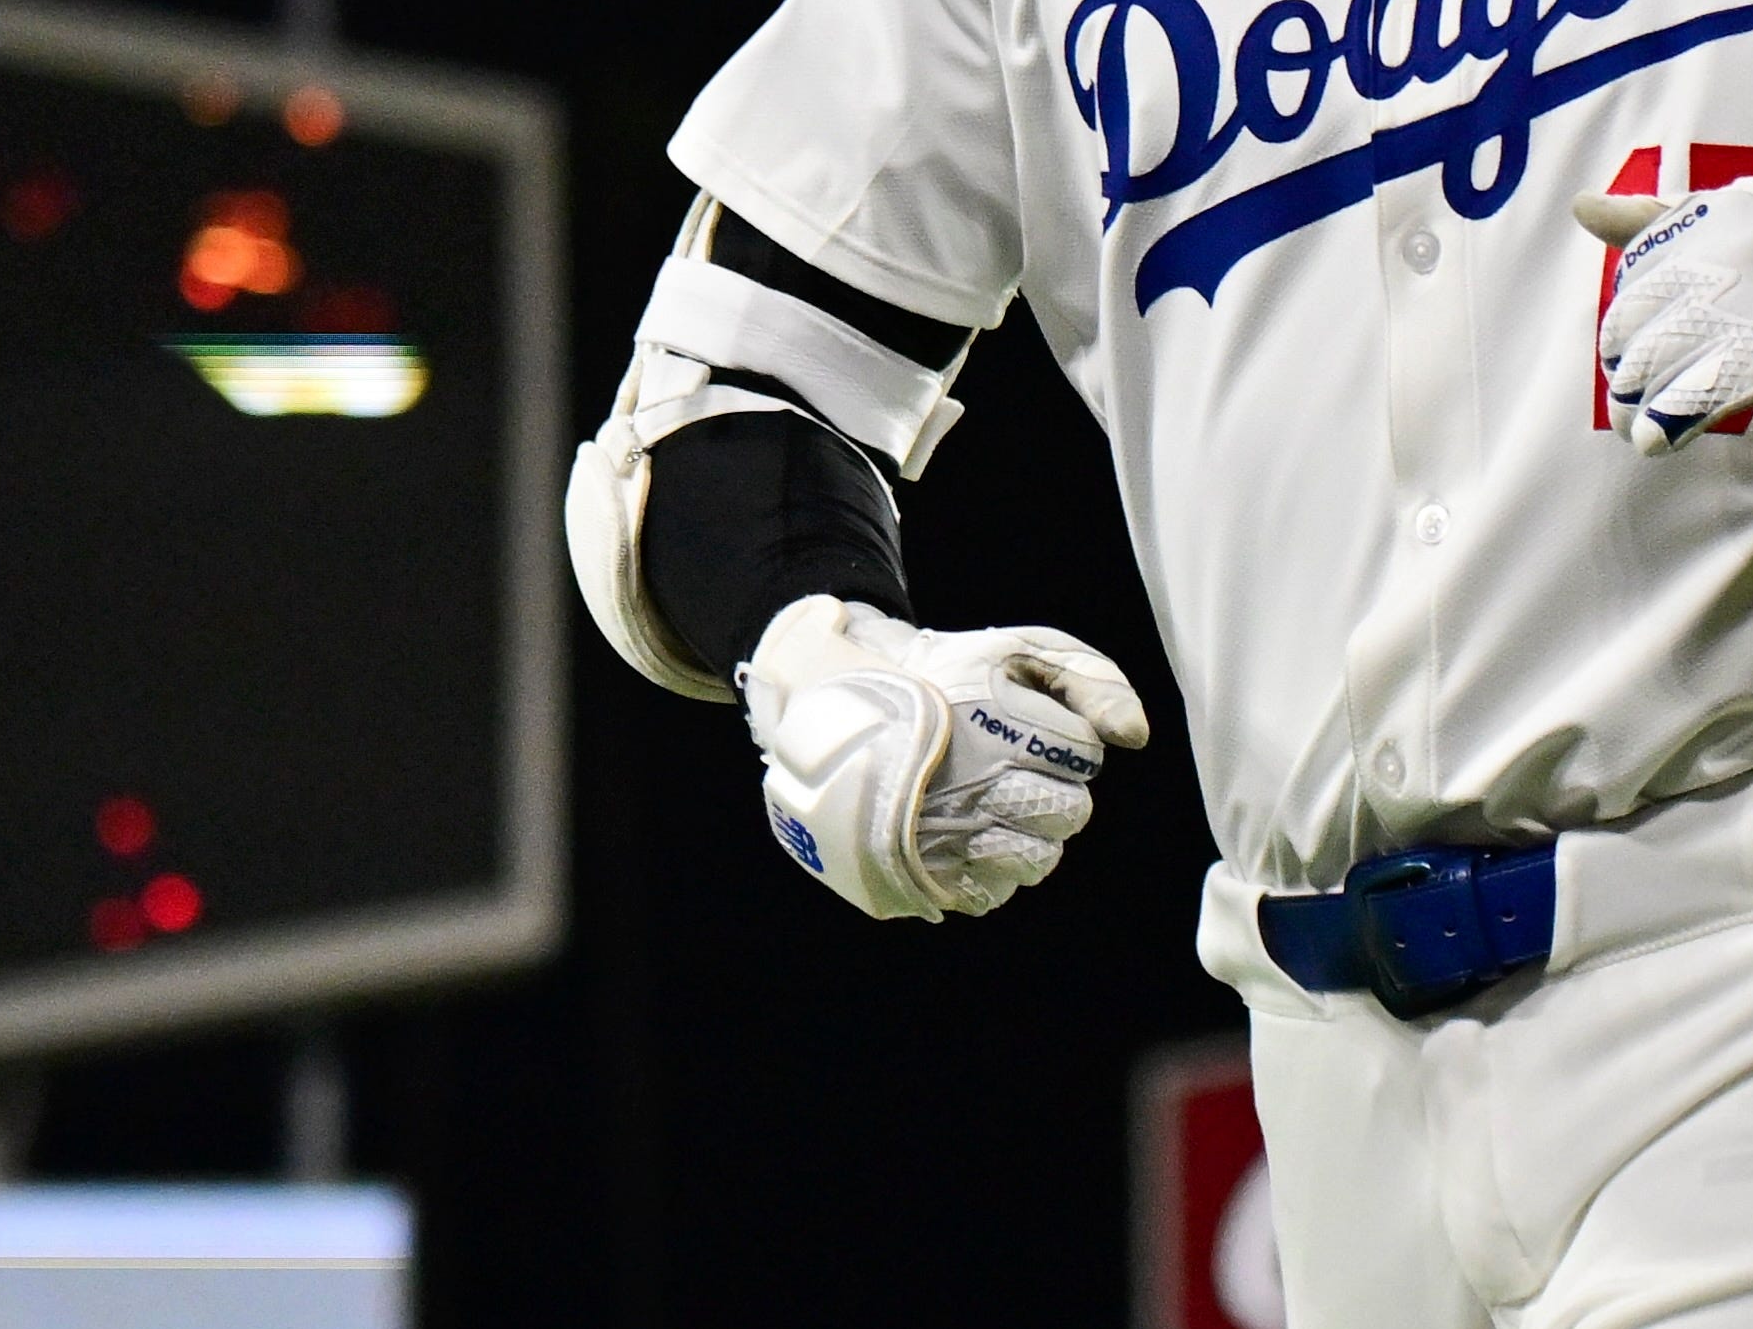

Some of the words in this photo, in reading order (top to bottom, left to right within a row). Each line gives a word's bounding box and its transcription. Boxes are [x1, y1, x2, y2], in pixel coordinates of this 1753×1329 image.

[1624, 204, 1709, 269] balance
[970, 708, 1024, 744] new
[1026, 734, 1100, 777] balan
